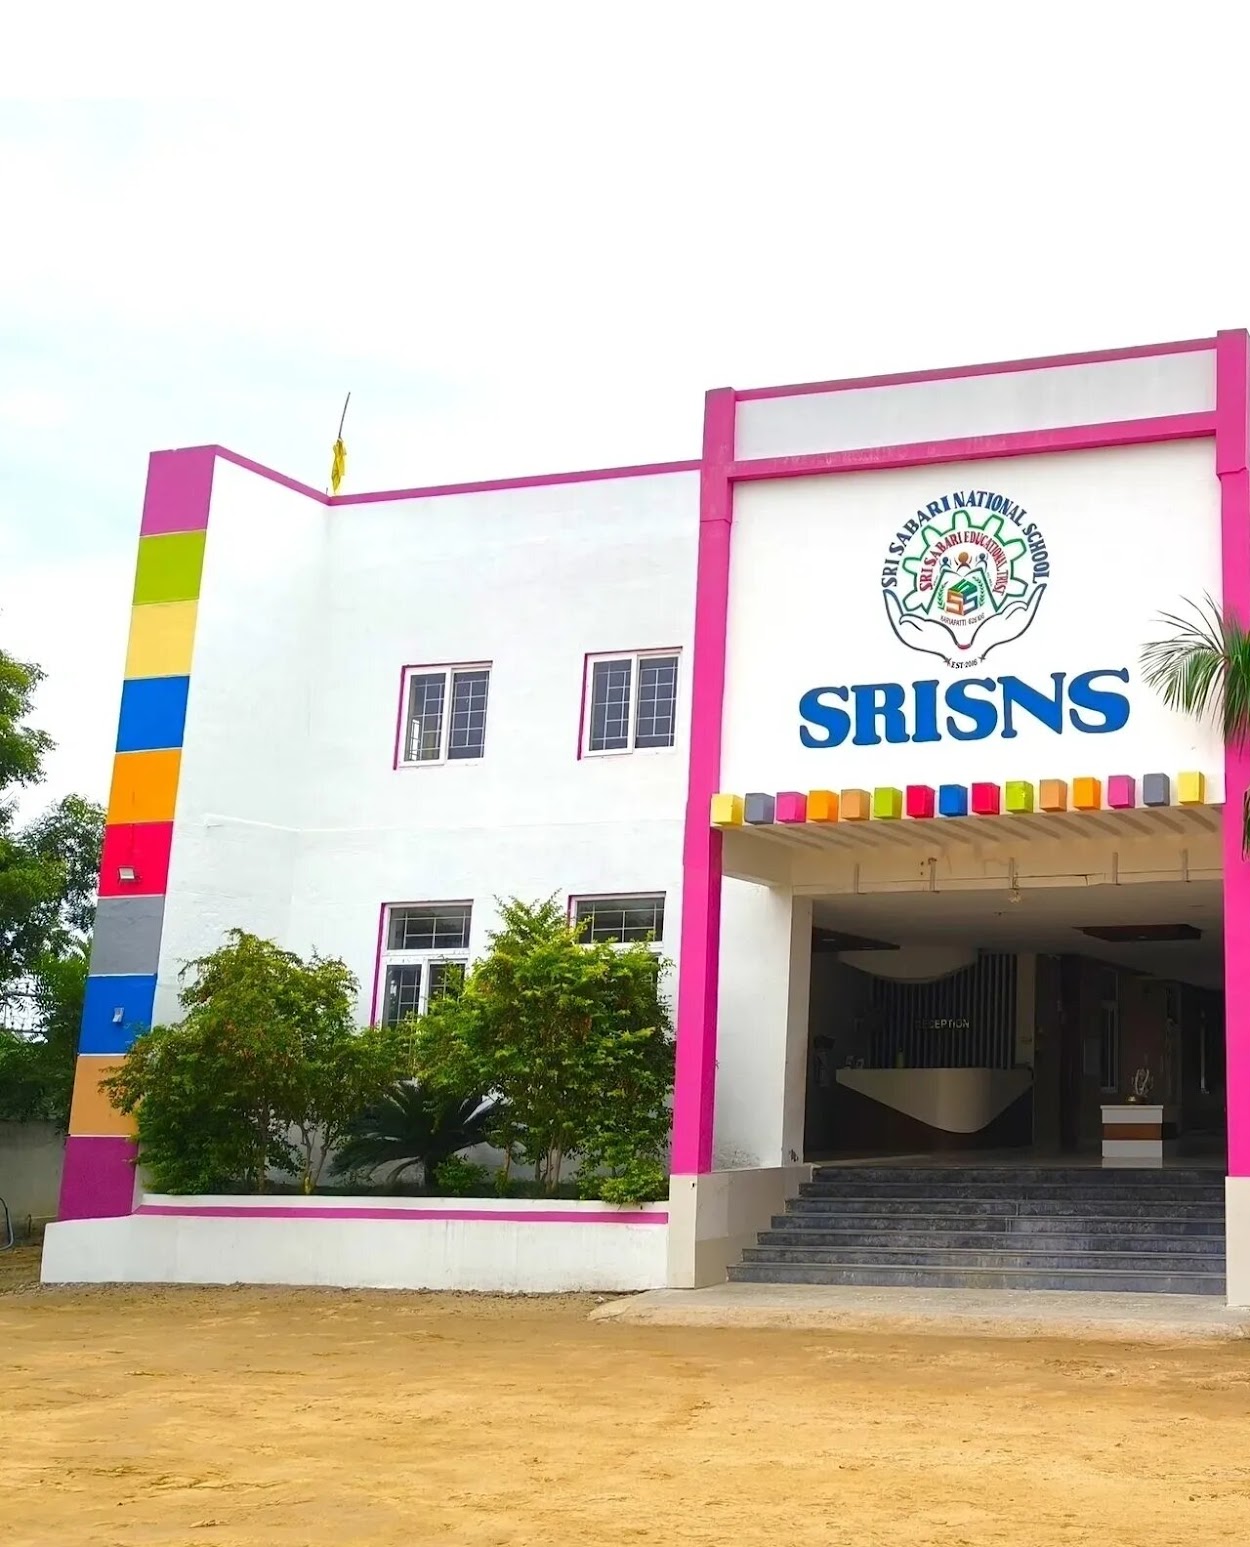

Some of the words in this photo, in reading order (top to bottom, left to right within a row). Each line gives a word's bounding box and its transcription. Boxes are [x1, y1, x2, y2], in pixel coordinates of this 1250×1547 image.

[889, 495, 951, 556] SABARI
[953, 490, 1027, 526] NATIONAL
[924, 533, 963, 567] SABARI
[1022, 523, 1050, 584] SCHOOL
[881, 559, 900, 587] SRI
[919, 568, 933, 592] SRI
[799, 668, 1130, 748] SRISNS
